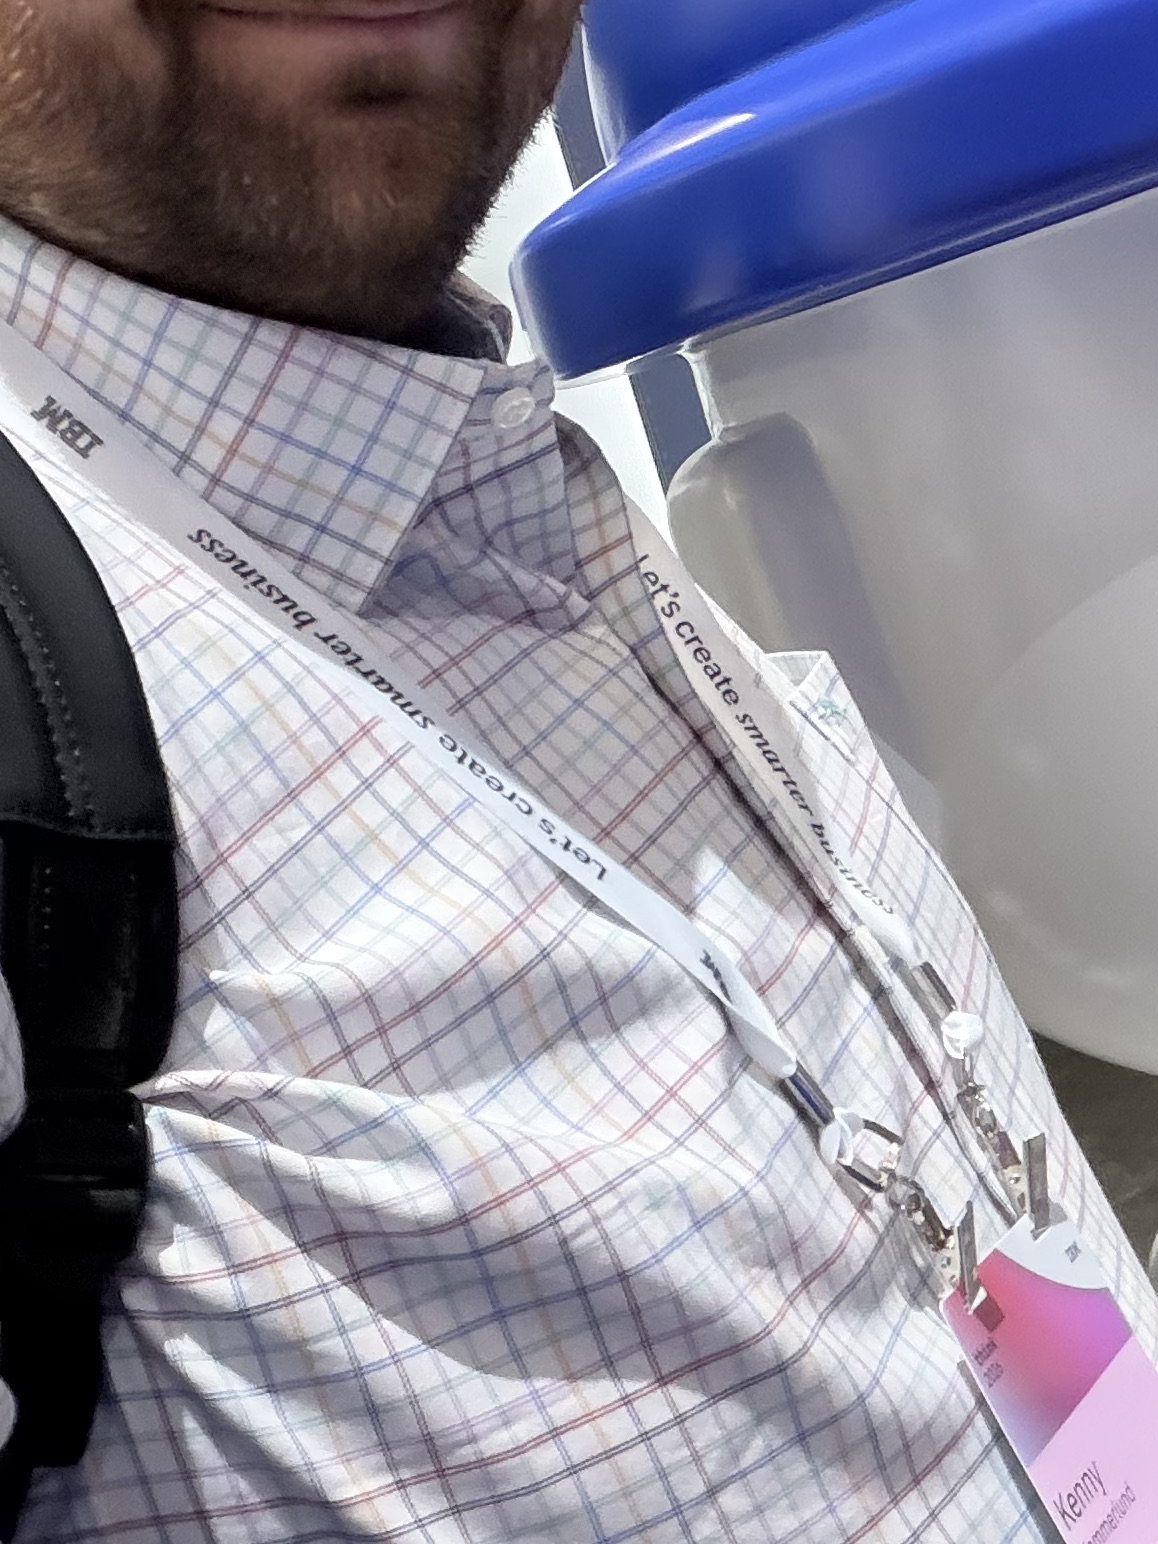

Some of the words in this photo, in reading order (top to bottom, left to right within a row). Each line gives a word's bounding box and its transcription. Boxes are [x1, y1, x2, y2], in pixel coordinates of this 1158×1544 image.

[30, 395, 104, 459] IBM
[187, 528, 319, 631] business
[315, 630, 436, 731] smarter
[675, 621, 740, 707] create
[736, 712, 815, 817] smarter
[439, 733, 534, 817] create
[540, 818, 607, 881] Let's
[1053, 1461, 1107, 1531] Kenny
